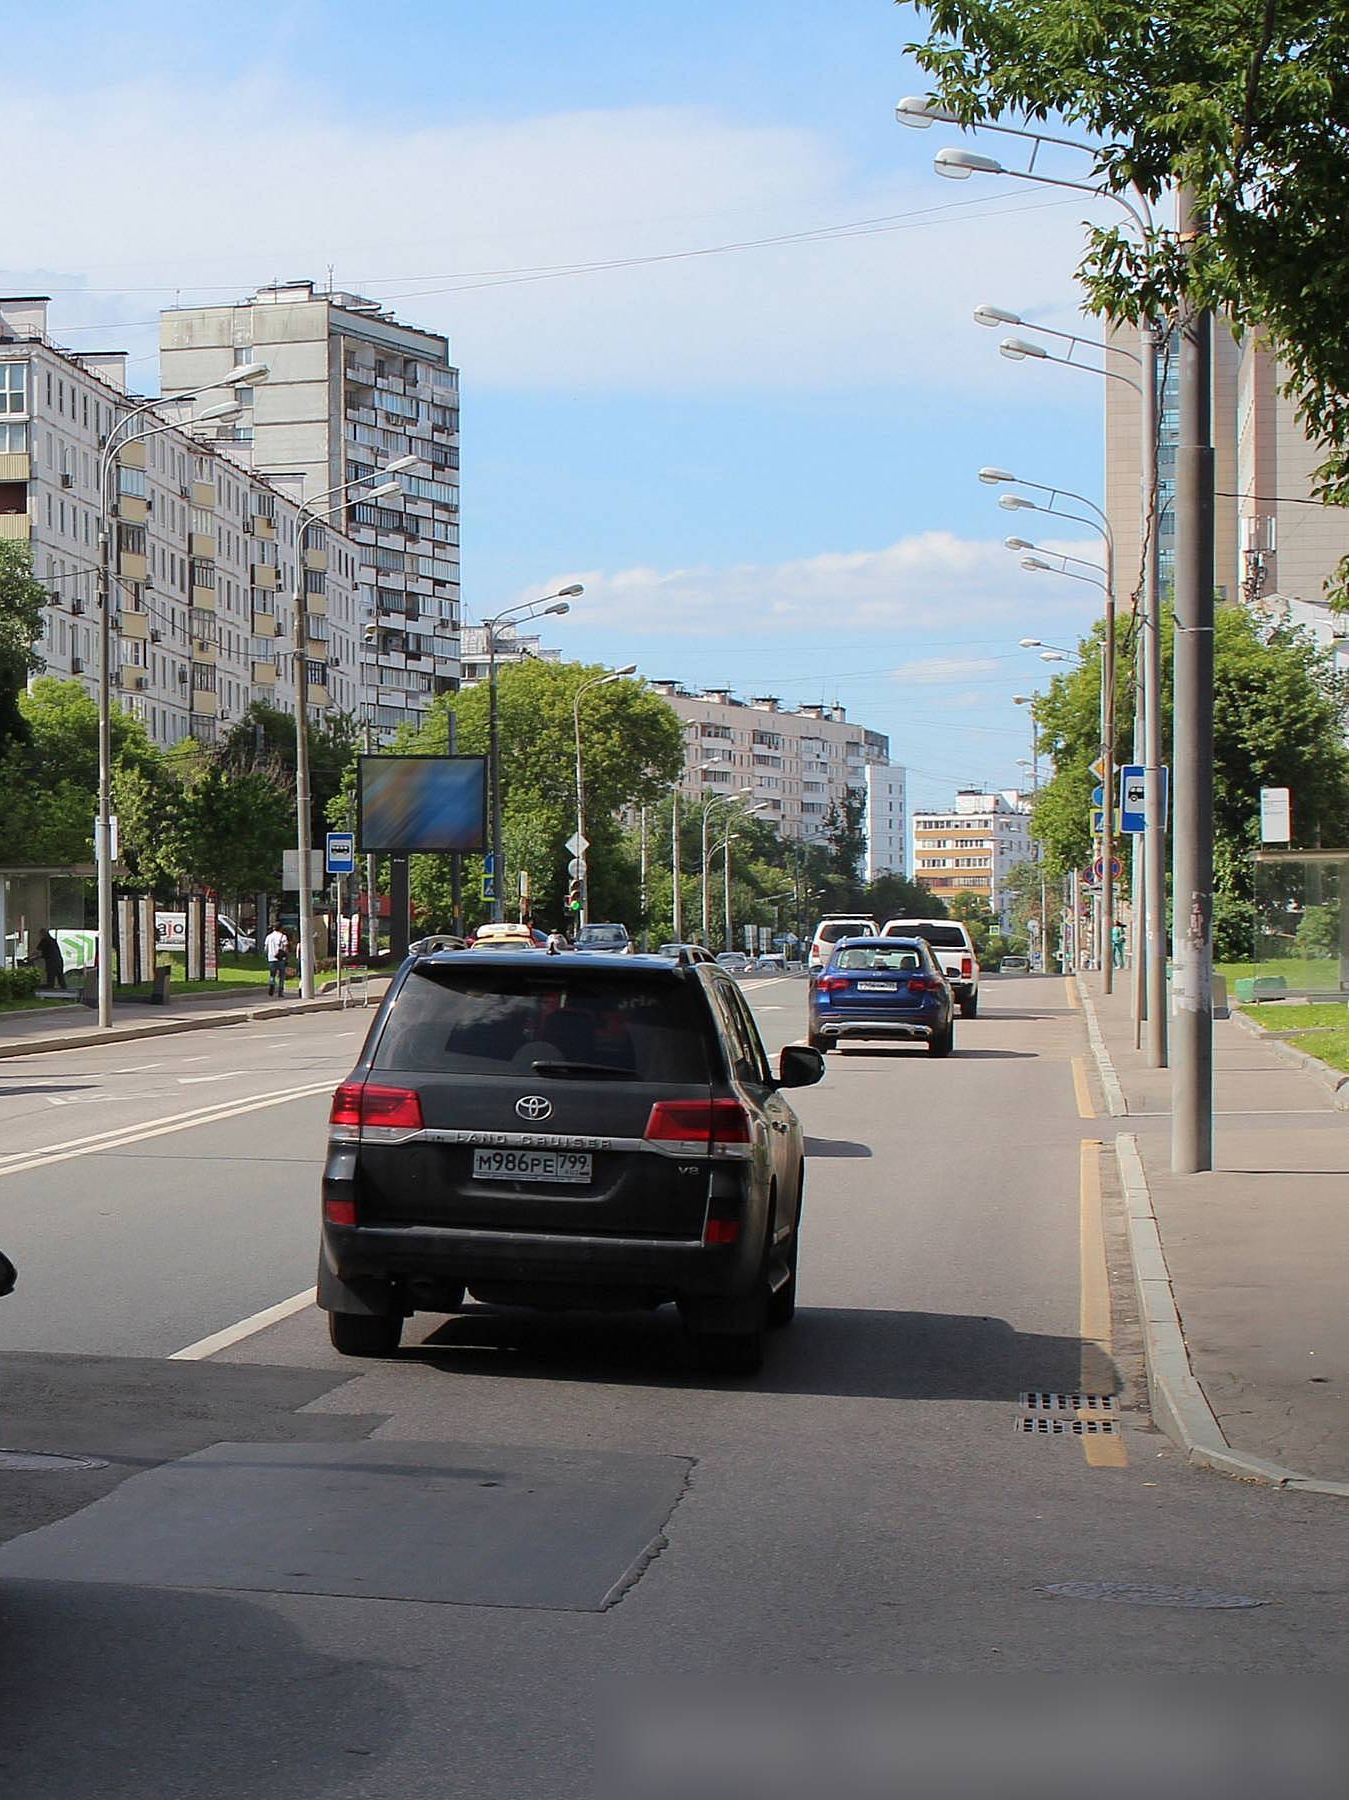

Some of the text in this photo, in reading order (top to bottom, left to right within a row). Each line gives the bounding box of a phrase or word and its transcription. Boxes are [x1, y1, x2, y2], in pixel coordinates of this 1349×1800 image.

[456, 1132, 613, 1149] LAND CRUISER
[558, 1154, 588, 1169] 799
